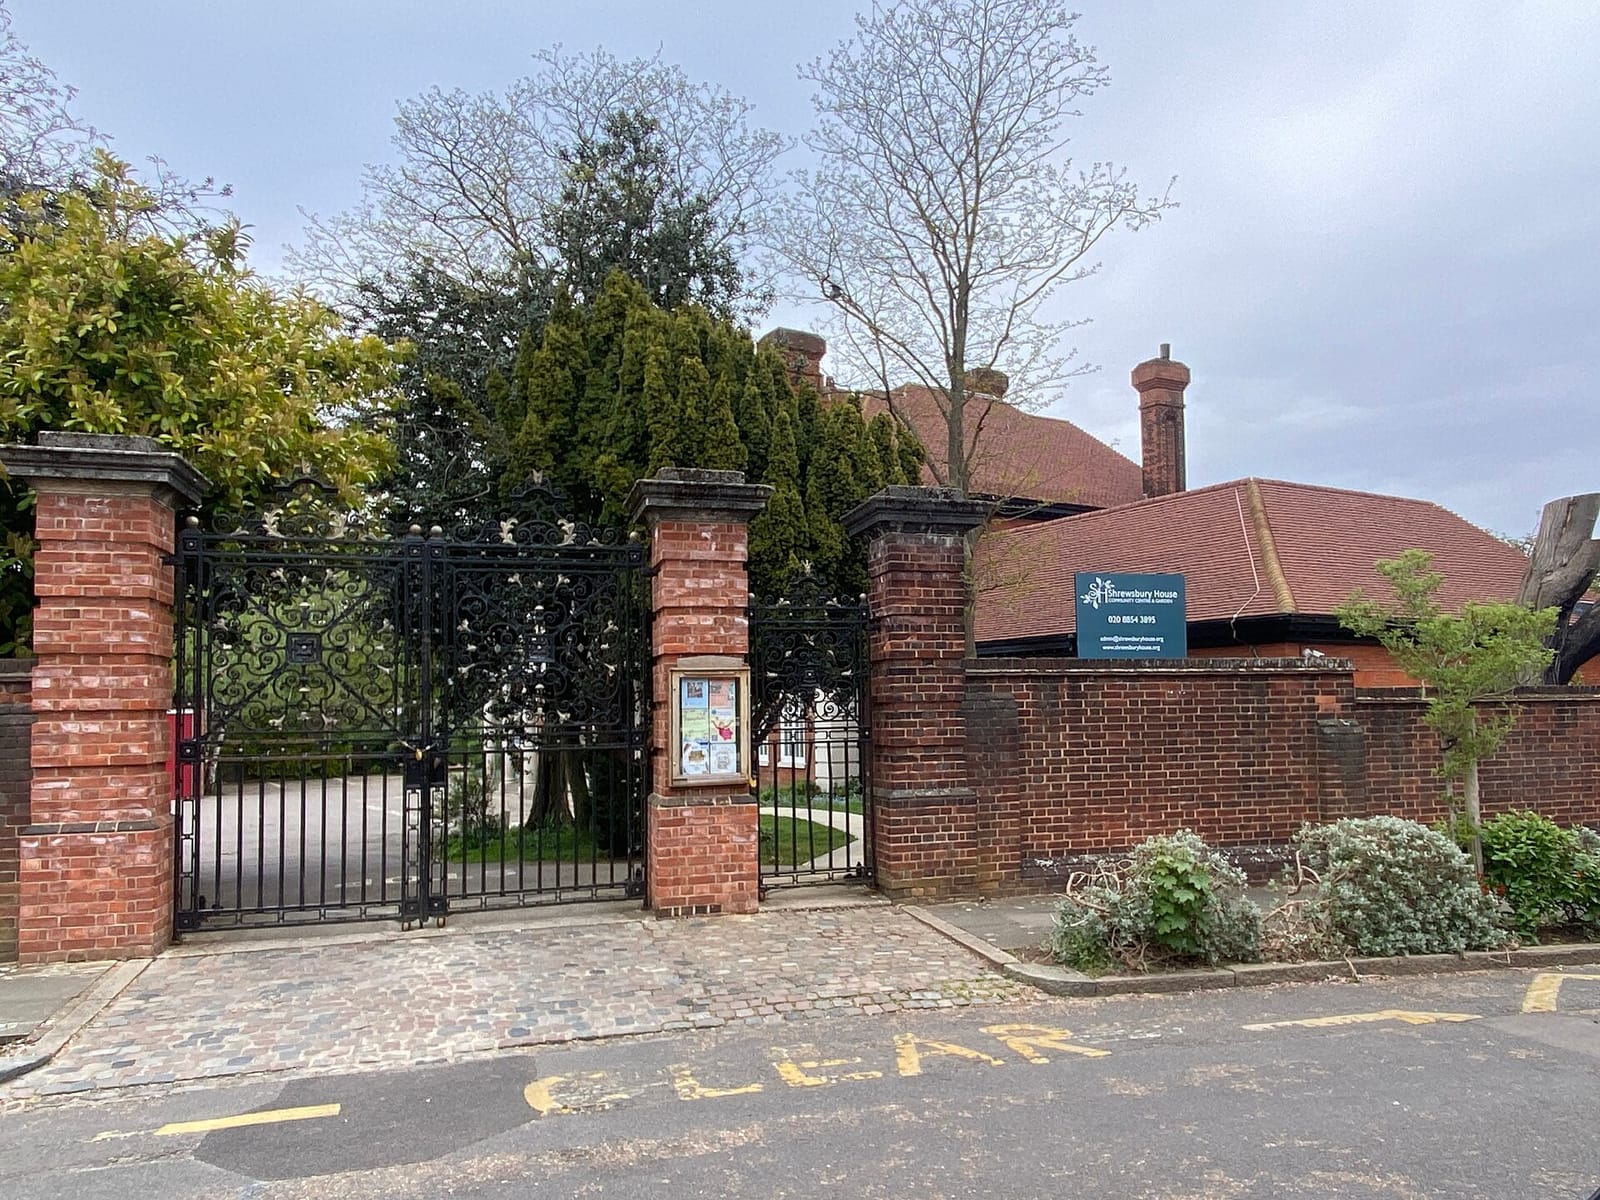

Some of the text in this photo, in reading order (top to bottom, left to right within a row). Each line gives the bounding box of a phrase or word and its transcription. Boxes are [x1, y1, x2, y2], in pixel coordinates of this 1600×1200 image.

[1108, 589, 1178, 599] Shrewsbury House
[1108, 616, 1121, 624] 020
